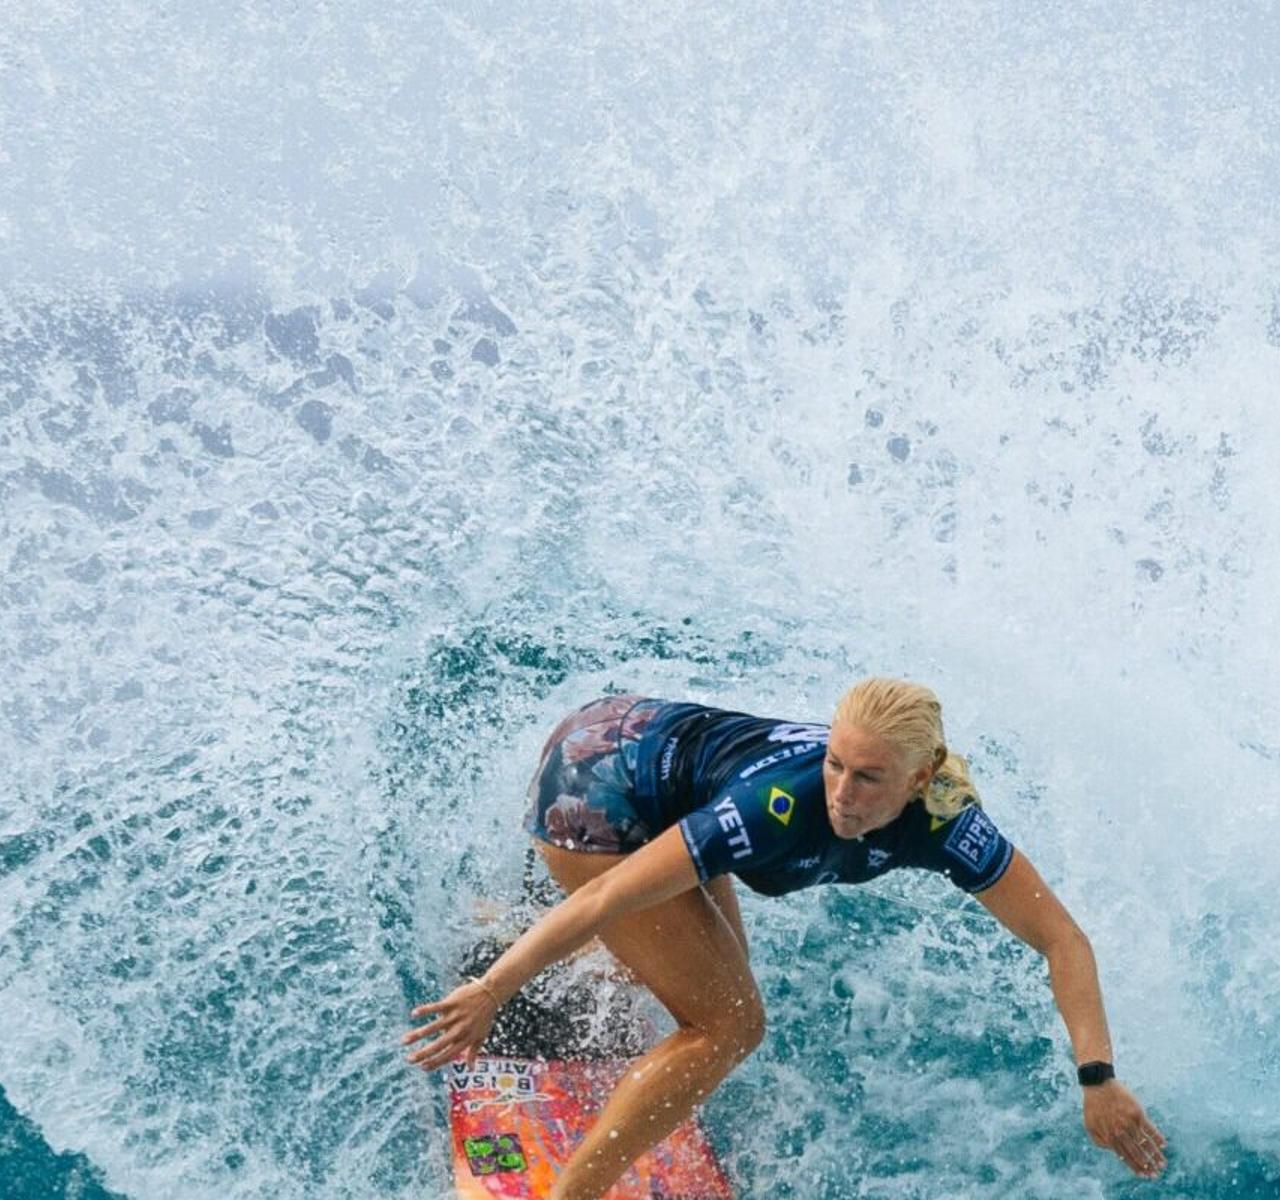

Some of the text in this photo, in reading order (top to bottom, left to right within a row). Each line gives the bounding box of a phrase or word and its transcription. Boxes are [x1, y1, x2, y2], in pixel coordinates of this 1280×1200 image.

[714, 795, 752, 859] YETI
[957, 813, 987, 854] PIPE
[452, 1060, 528, 1075] ATLEA
